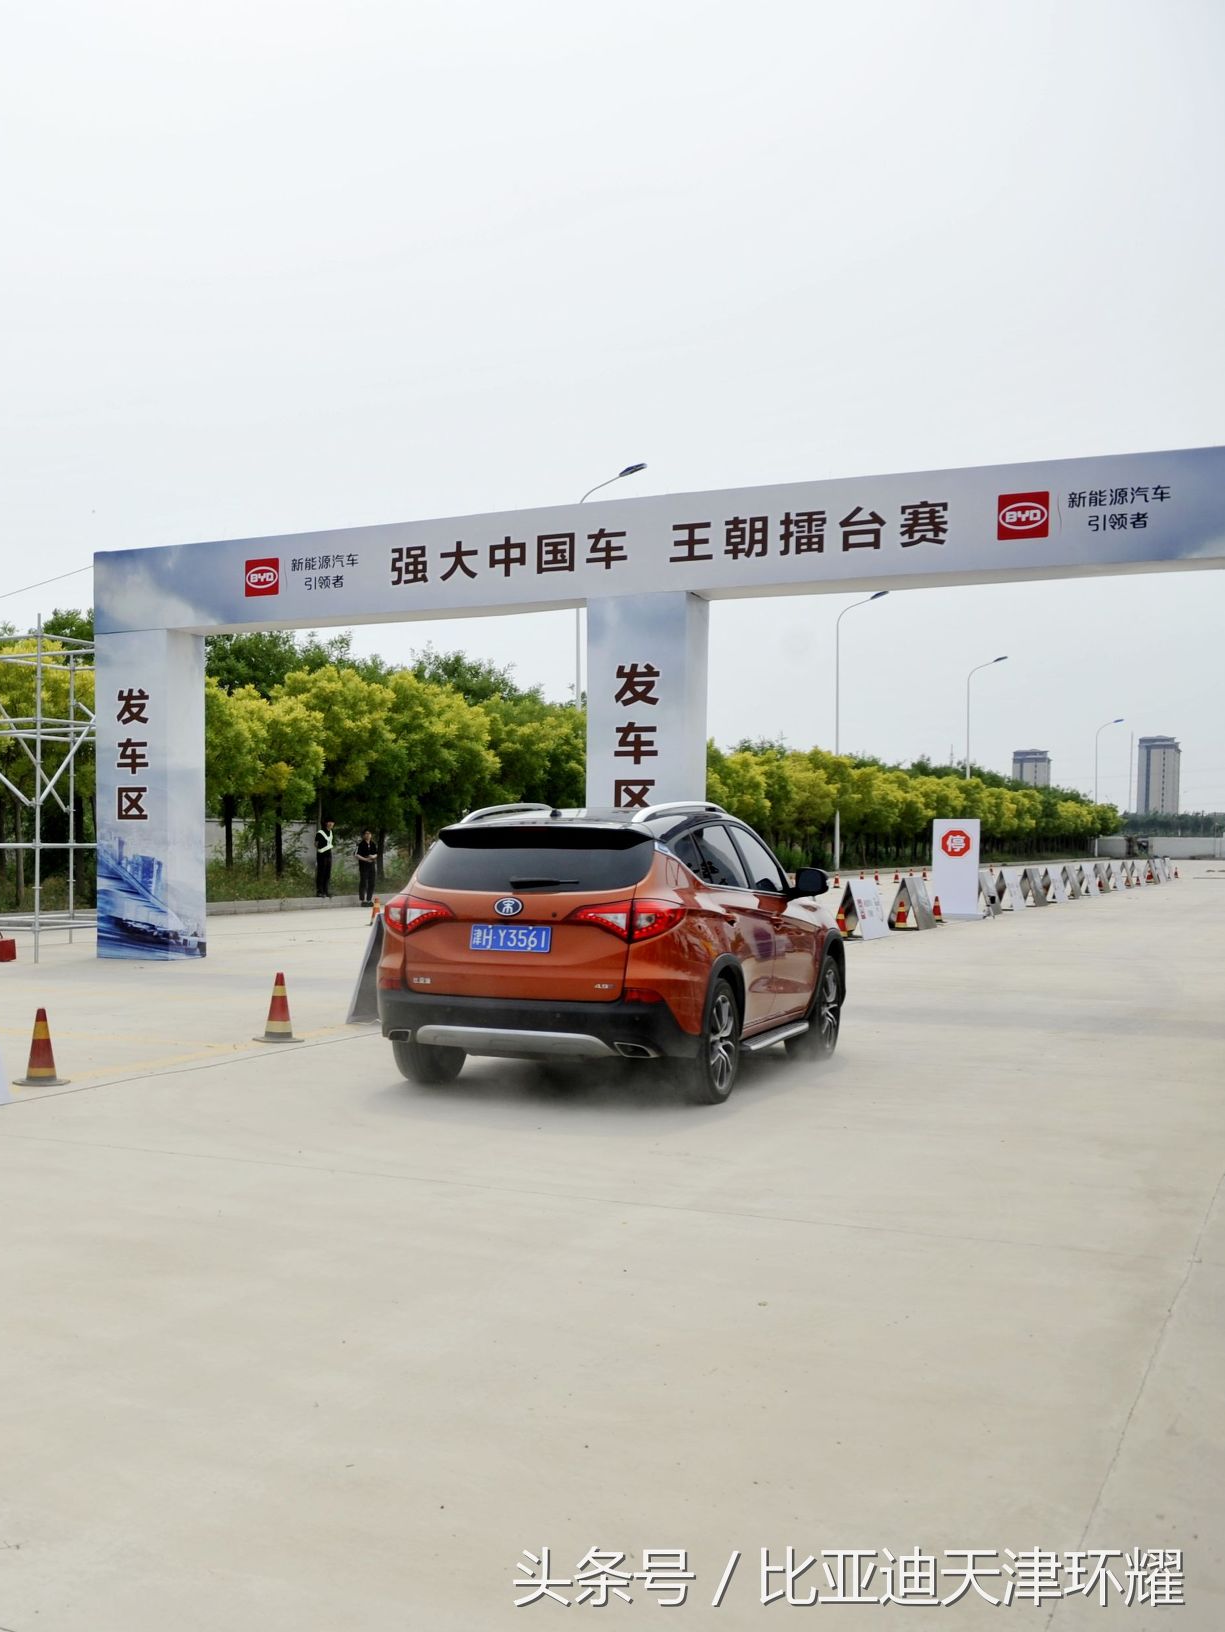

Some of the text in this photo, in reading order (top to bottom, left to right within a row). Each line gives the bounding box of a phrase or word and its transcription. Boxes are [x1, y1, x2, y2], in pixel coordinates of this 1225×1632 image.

[1067, 484, 1172, 510] 新能源汽车
[1005, 508, 1042, 524] BYD
[1088, 511, 1149, 532] 引领者
[390, 501, 950, 586] 强大中国车 王朝擂台赛
[290, 553, 359, 572] 新能源汽车
[248, 571, 276, 583] BYD
[304, 575, 345, 590] 引领者
[614, 663, 660, 808] 发车区
[116, 688, 150, 820] 发车区
